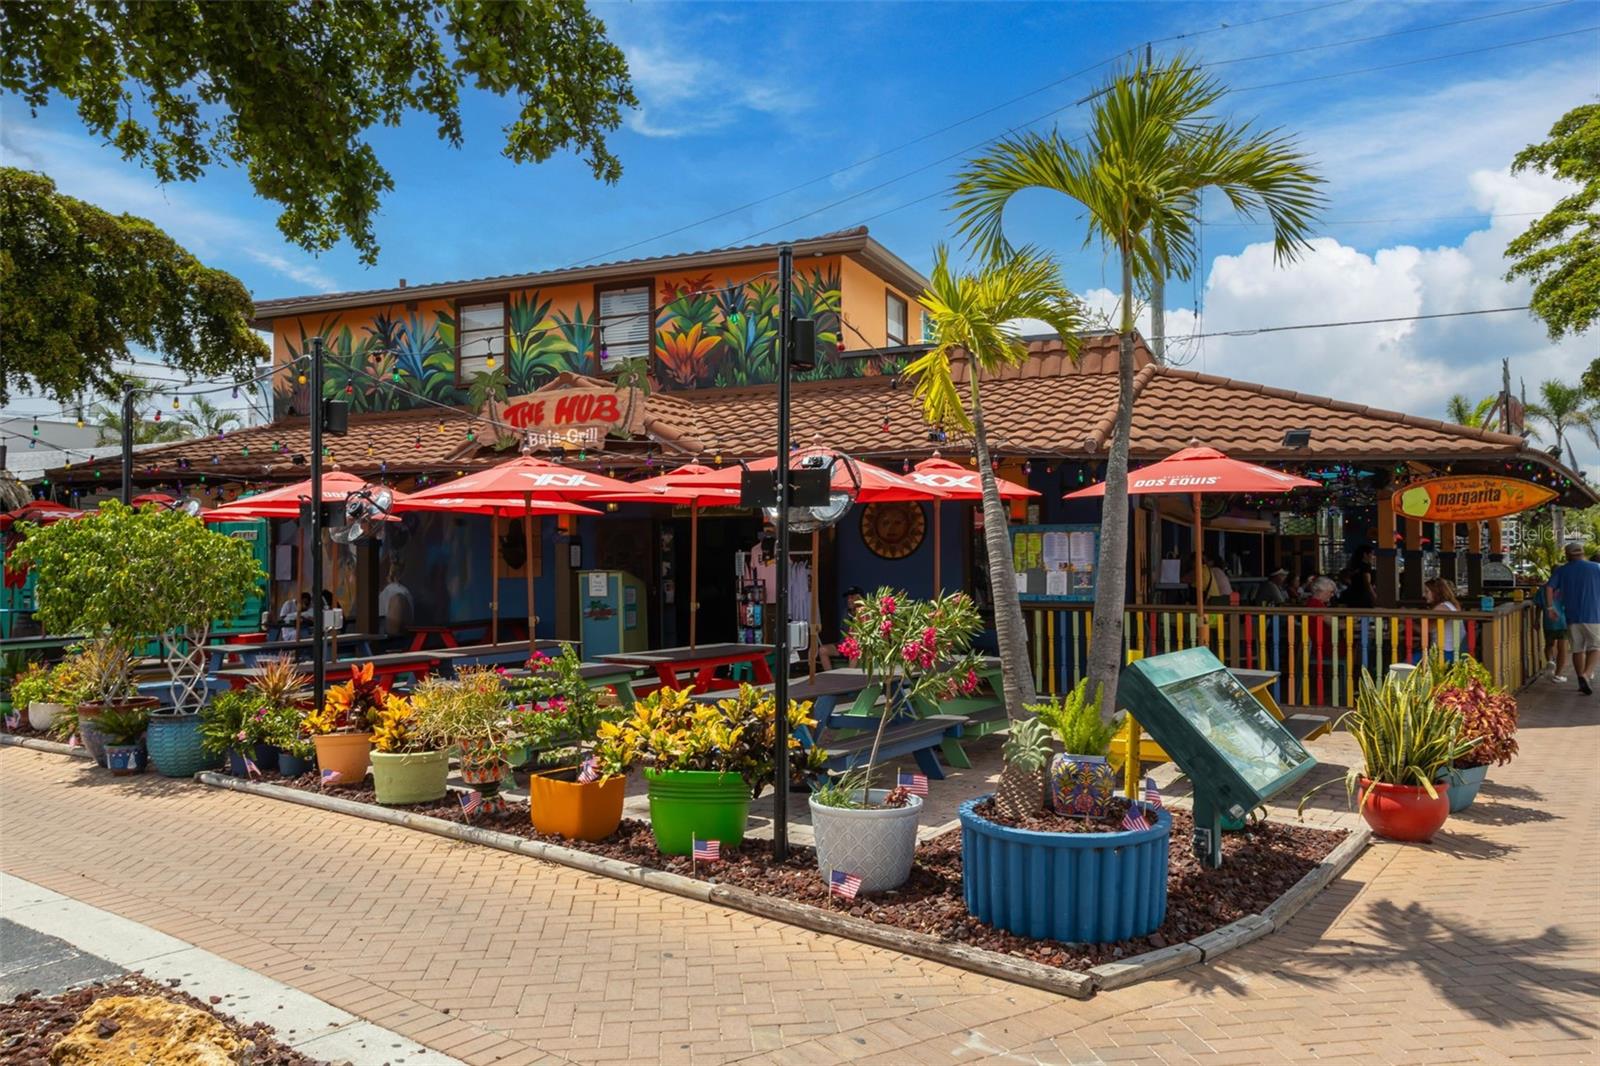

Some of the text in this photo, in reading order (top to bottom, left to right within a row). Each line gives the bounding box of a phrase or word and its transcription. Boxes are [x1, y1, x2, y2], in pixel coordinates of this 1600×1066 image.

[503, 394, 621, 429] THE HUB
[528, 427, 598, 448] Baja-Grill
[1133, 478, 1166, 488] DOS
[1168, 475, 1219, 486] EQUIS
[1436, 488, 1501, 506] margarita
